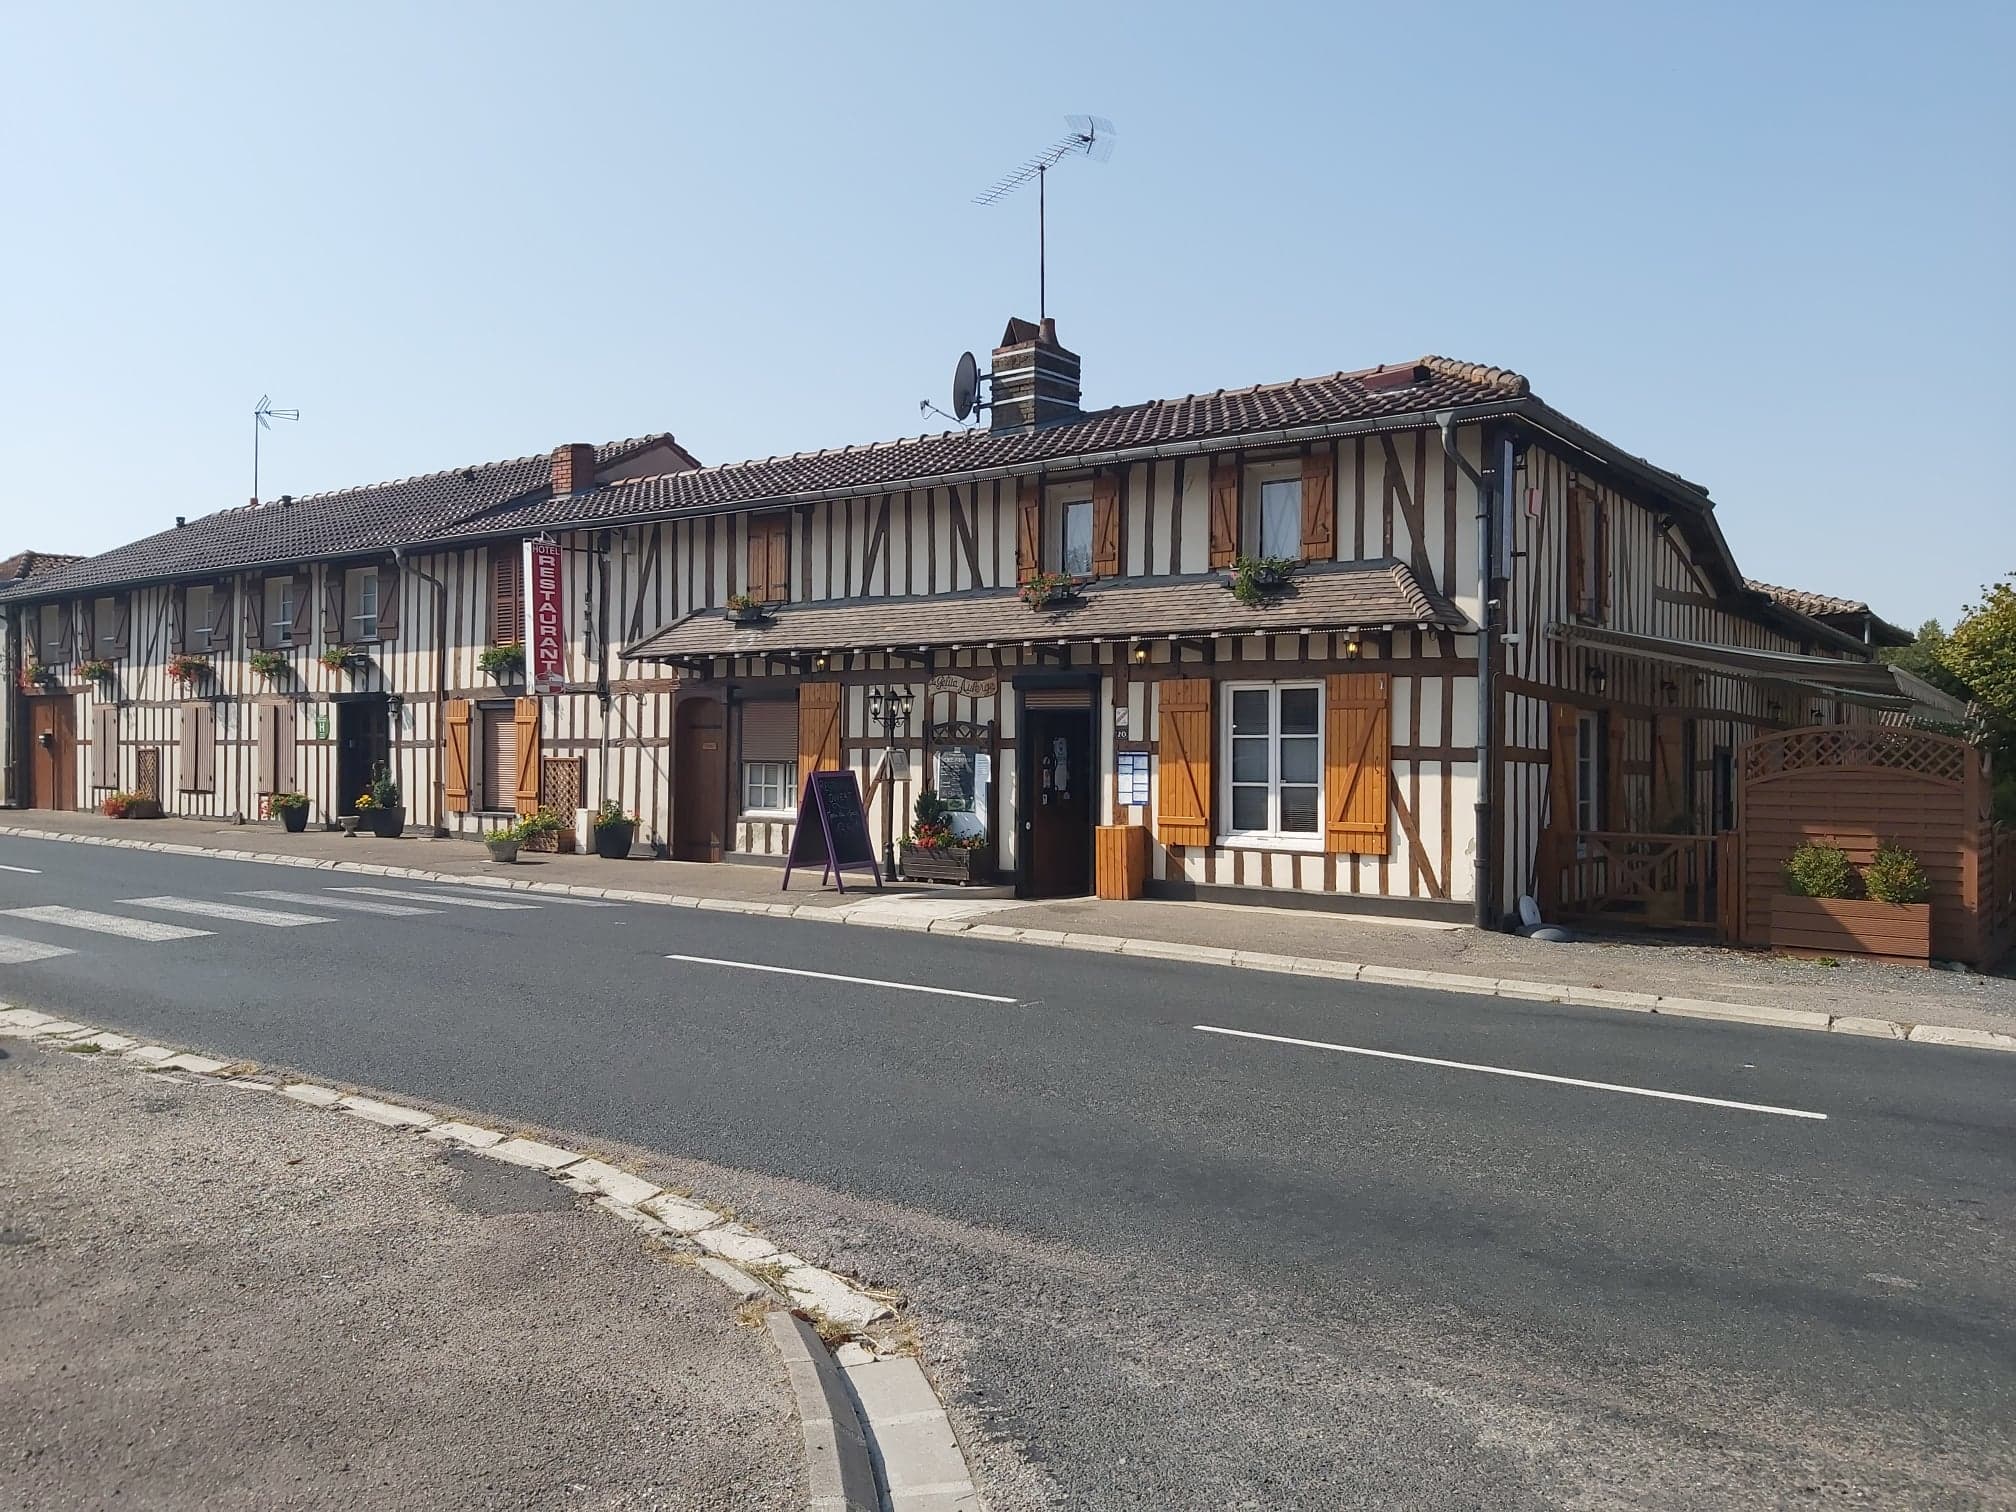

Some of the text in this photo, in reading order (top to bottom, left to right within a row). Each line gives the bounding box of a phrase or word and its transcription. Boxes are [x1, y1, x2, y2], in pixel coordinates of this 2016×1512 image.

[533, 545, 560, 555] HOTEL
[538, 556, 558, 671] RESTAURANT
[319, 722, 325, 732] H
